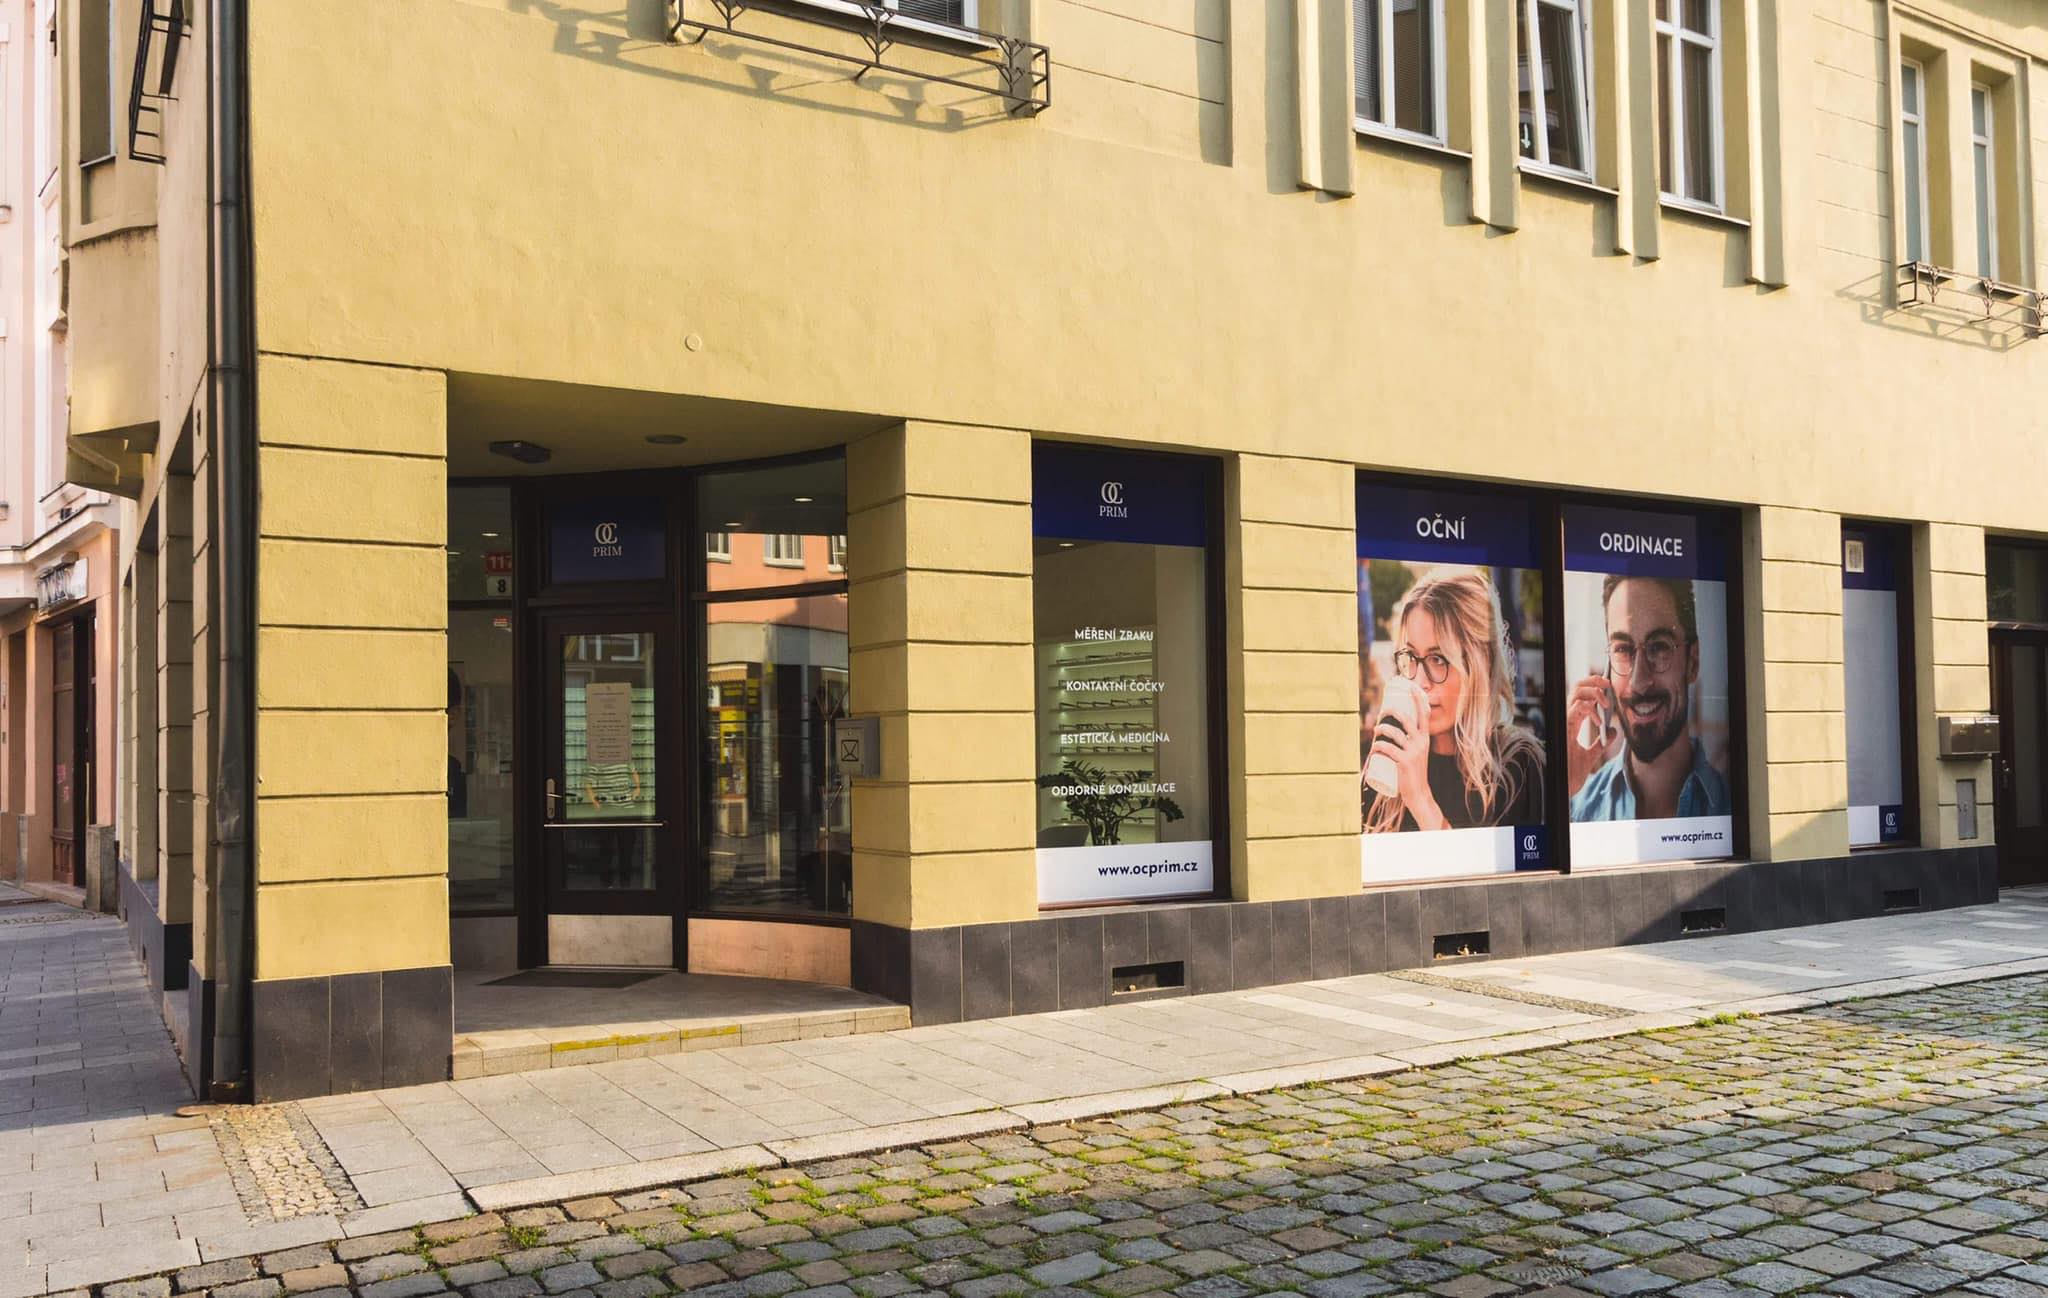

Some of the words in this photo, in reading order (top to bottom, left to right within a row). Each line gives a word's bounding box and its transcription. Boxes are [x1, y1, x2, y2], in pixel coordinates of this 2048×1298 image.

[1099, 505, 1128, 518] PRIM
[1416, 513, 1466, 540] OČNÍ
[593, 545, 622, 557] PRIM
[1600, 532, 1683, 557] ORDINACE
[497, 579, 506, 593] 8
[1075, 627, 1117, 640] MĚŘENÍ
[1119, 630, 1154, 641] ZRAKU
[1066, 679, 1127, 692] KONTAKTNÍ
[1129, 680, 1165, 692] ČOČKY
[1061, 731, 1116, 744] ESTETICKÁ
[1119, 730, 1170, 743] MEDICÍNA
[1051, 784, 1105, 797] ODBORNÉ
[1108, 783, 1177, 795] KONZULTACE
[1661, 830, 1723, 844] www.ocprim.cz
[1098, 860, 1198, 878] www.ocprim.cz
